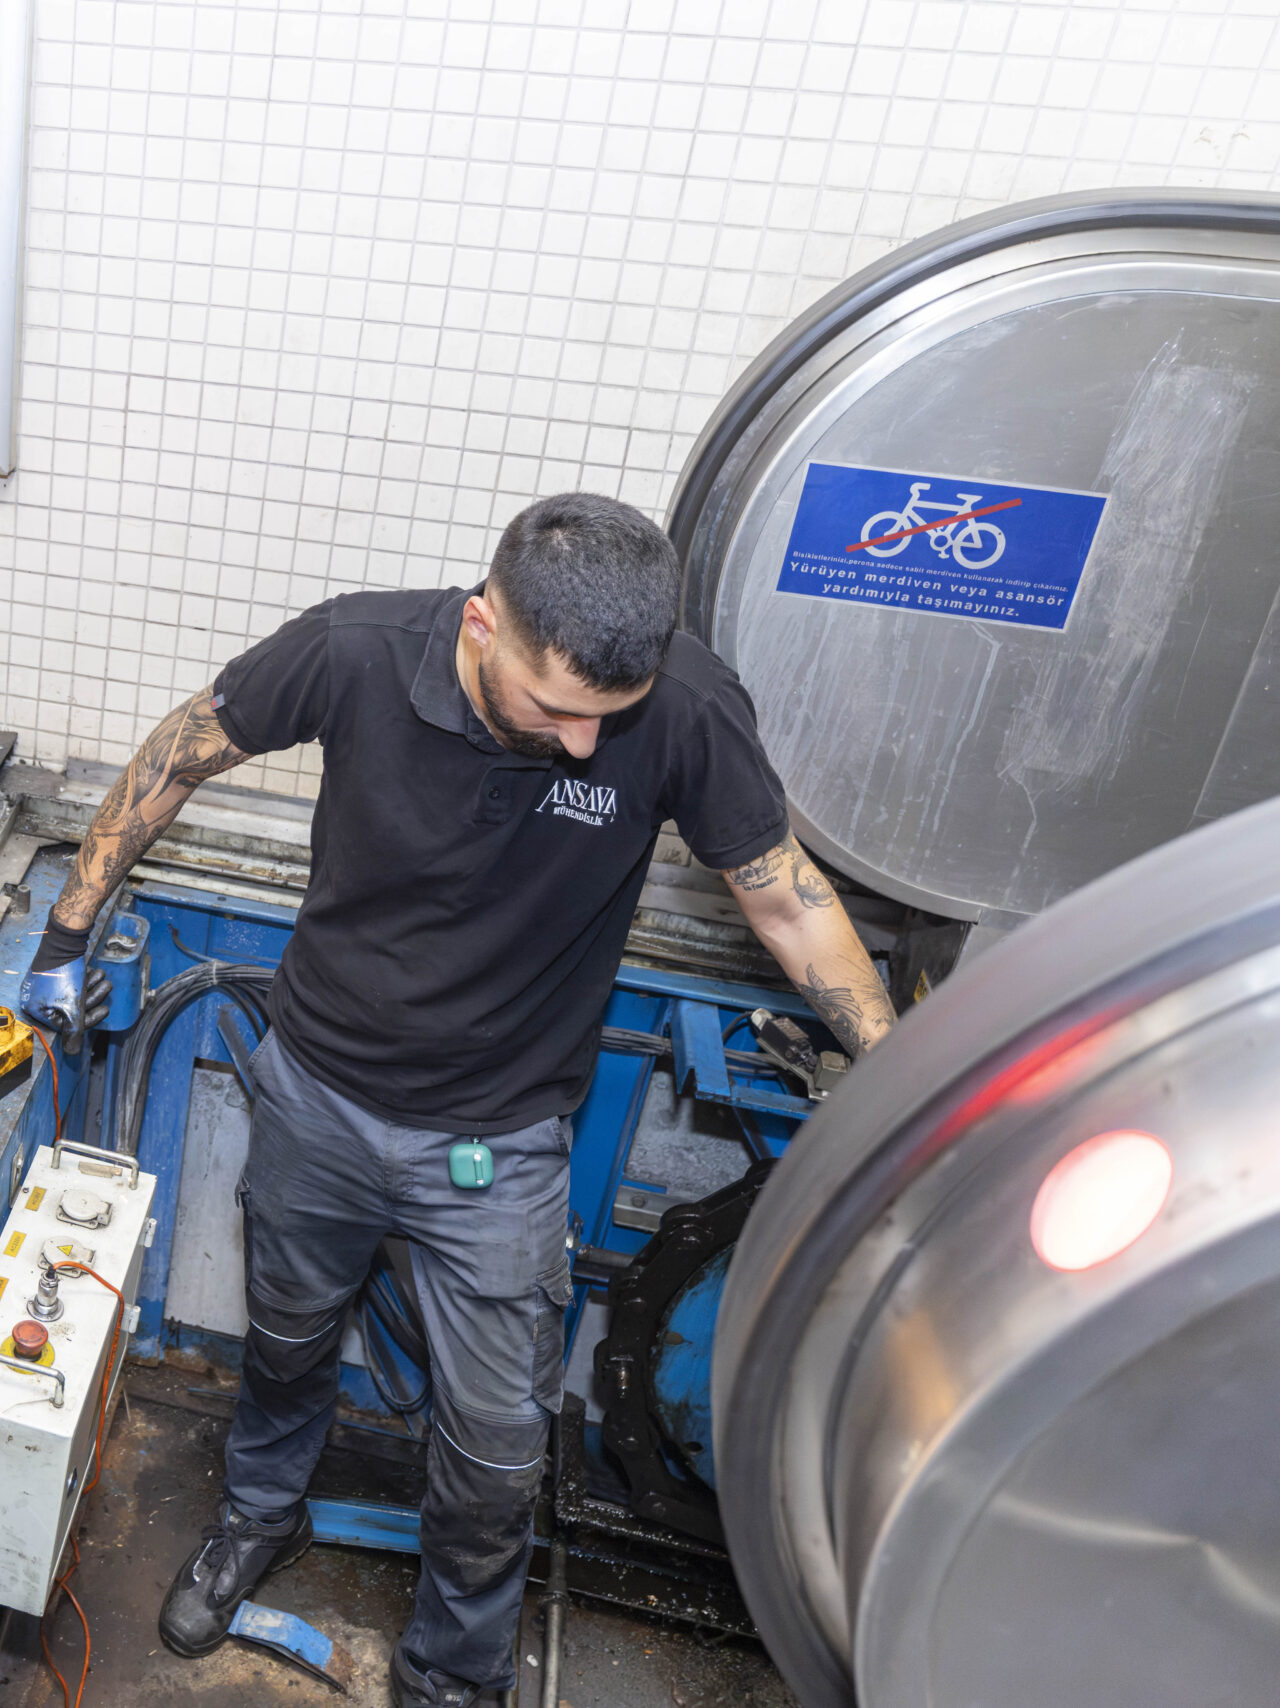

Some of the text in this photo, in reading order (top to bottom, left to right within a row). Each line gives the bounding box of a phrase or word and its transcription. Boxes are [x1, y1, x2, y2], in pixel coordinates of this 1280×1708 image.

[790, 561, 1065, 606] Yürüyen merdiven veya asansör
[822, 583, 1020, 616] yardımıyla taşımayınız.
[534, 779, 616, 822] ANSAVA
[553, 805, 603, 826] MÜHENDİSLİK
